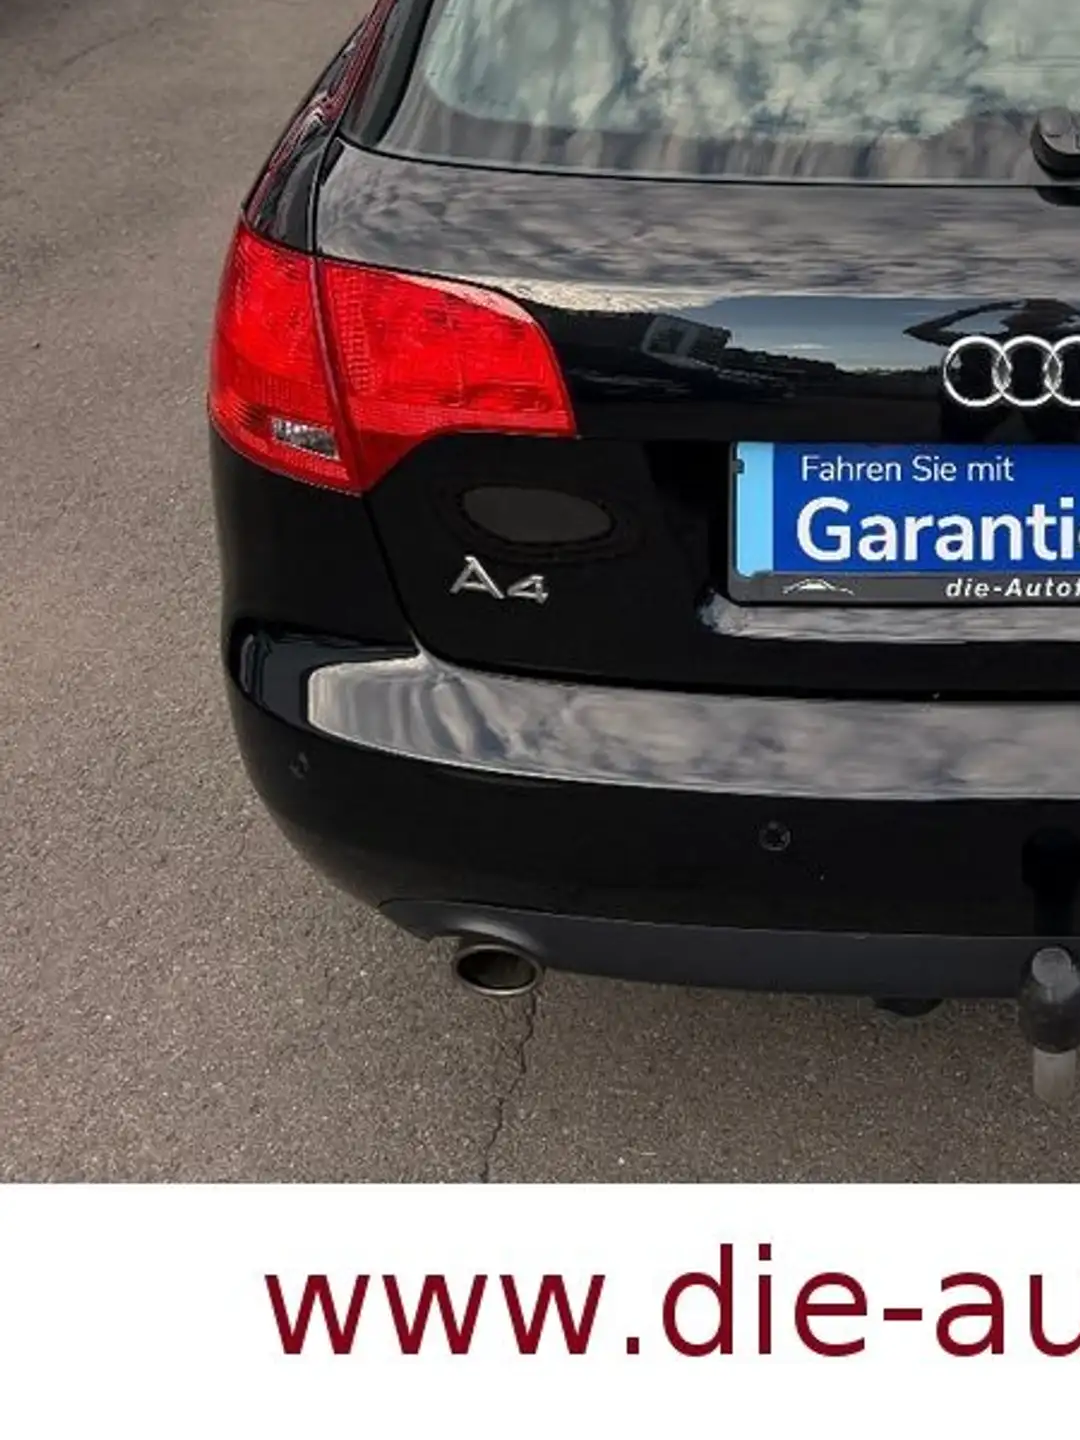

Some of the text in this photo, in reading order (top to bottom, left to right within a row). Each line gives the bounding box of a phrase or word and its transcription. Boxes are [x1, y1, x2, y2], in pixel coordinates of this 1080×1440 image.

[802, 455, 1014, 482] Fahren Sie mit
[450, 555, 549, 604] A4
